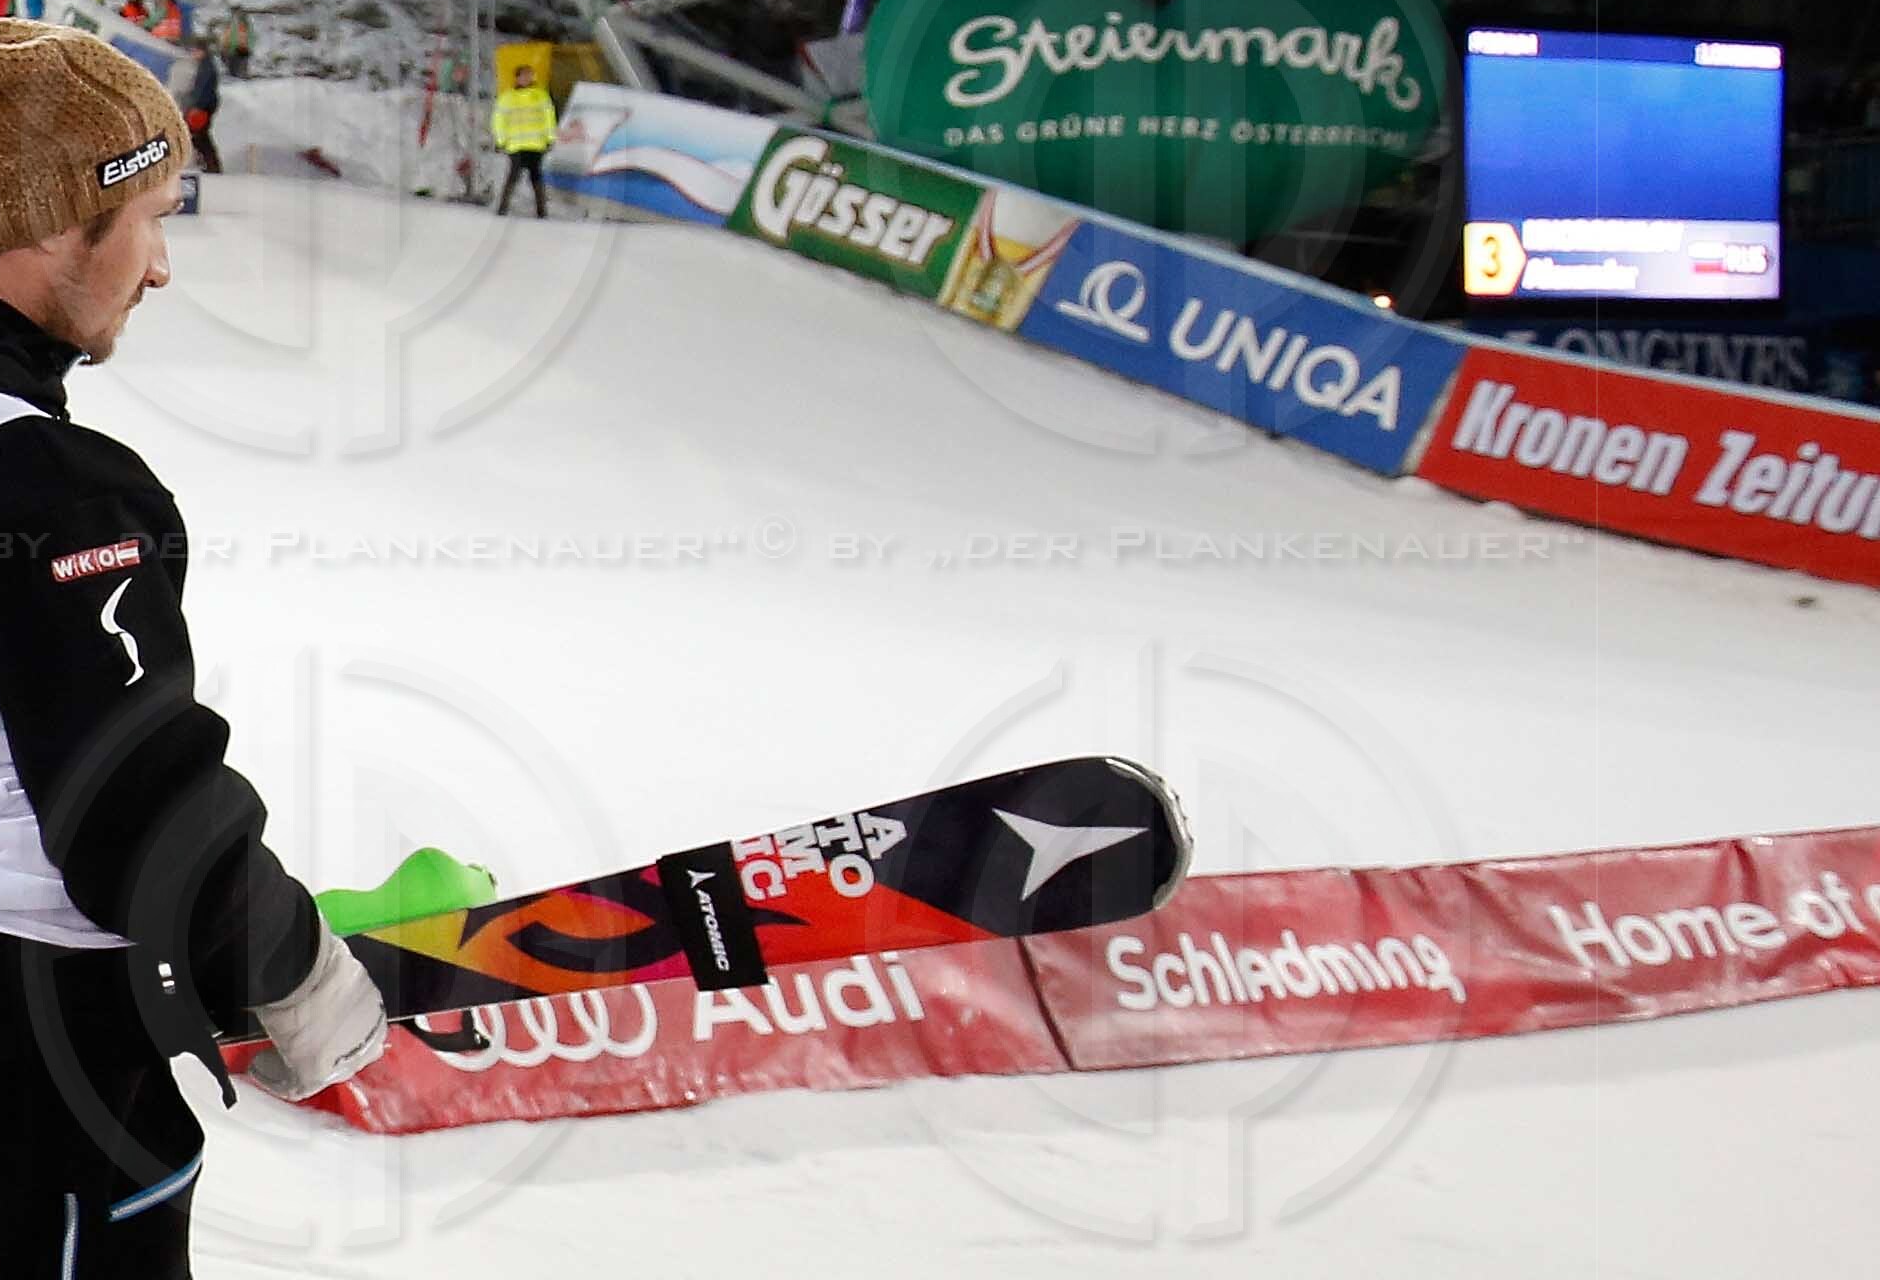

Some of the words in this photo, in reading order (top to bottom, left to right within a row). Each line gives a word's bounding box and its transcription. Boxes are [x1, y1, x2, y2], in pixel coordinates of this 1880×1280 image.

[943, 11, 1422, 111] Steiermark
[102, 139, 170, 187] Eisbär
[944, 123, 1005, 147] DAS
[1015, 113, 1124, 140] GRÜNE
[1137, 115, 1218, 141] HERZ
[1480, 235, 1503, 278] 3
[1168, 296, 1403, 432] UNIQA
[1451, 378, 1689, 496] Kronen
[696, 888, 730, 971] ATOMIC
[1548, 898, 1789, 970] Home
[1787, 869, 1867, 940] of
